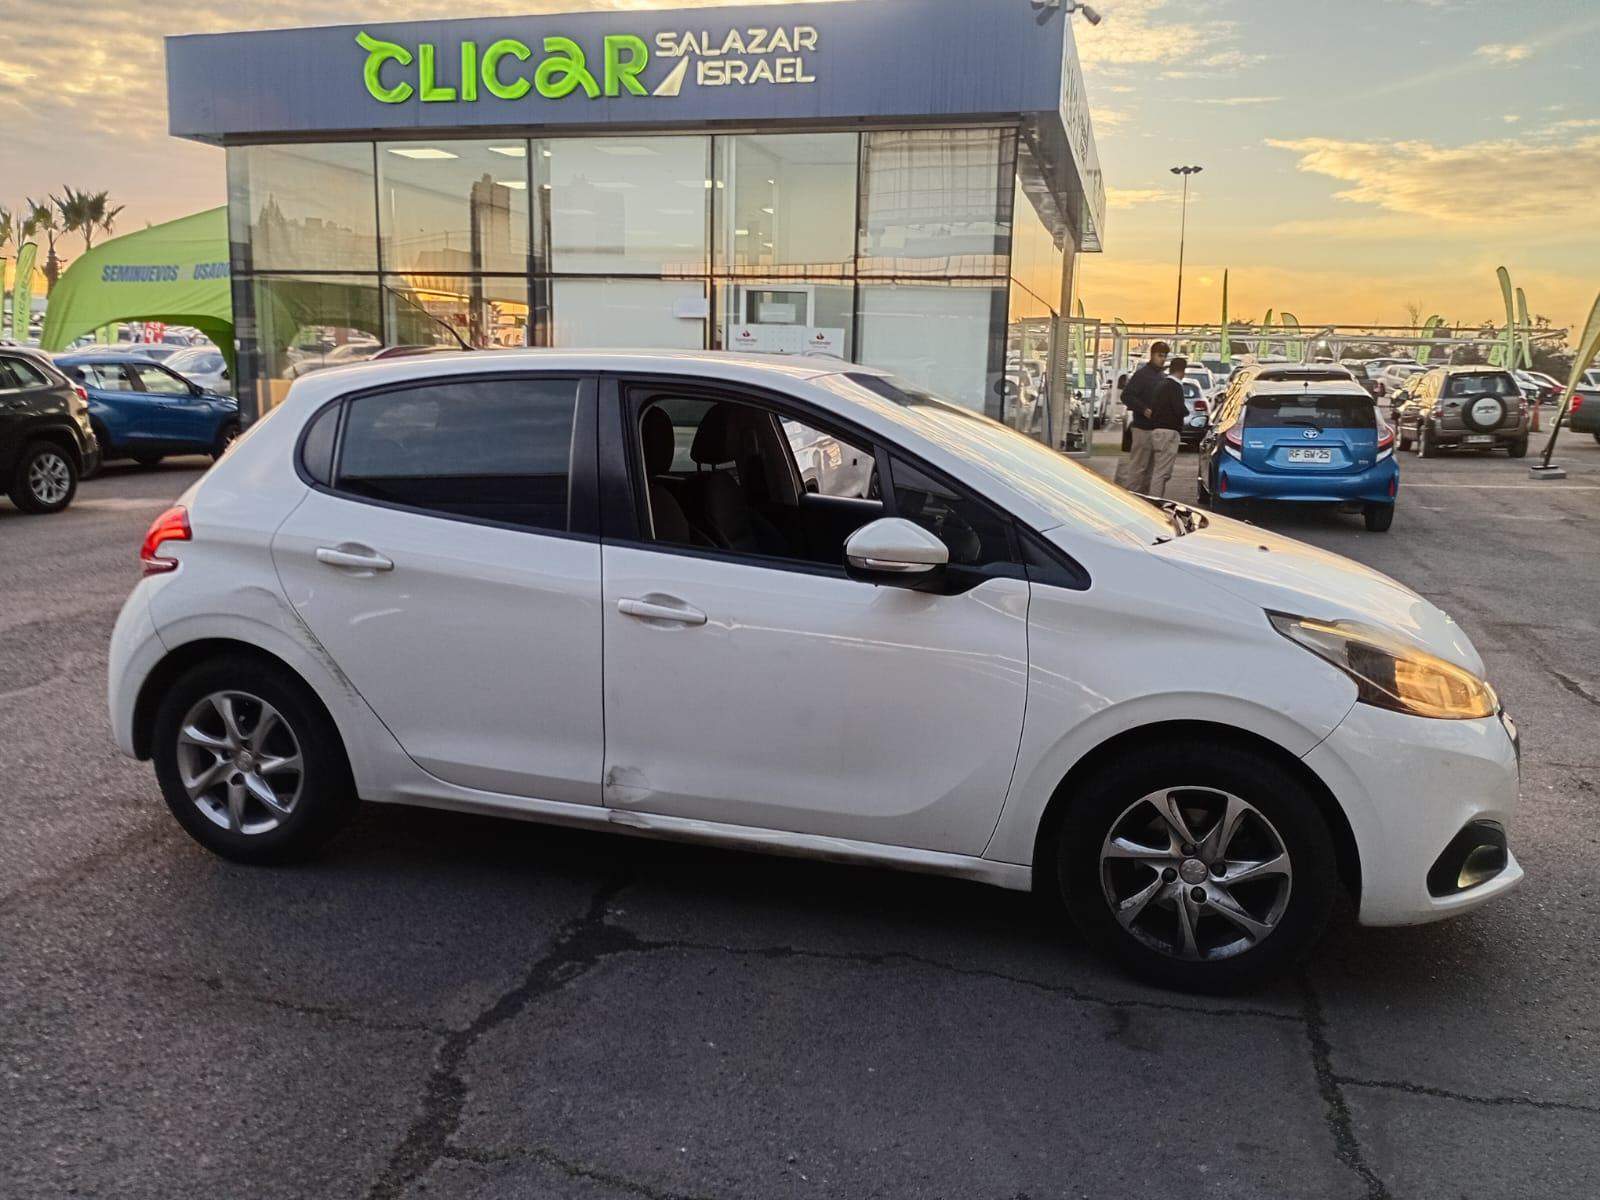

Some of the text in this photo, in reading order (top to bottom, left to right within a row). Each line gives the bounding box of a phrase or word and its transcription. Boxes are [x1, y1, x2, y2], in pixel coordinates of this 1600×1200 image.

[655, 26, 818, 57] SALAZAR
[697, 57, 816, 86] ISRAEL
[102, 265, 178, 281] SEMINUEVOS
